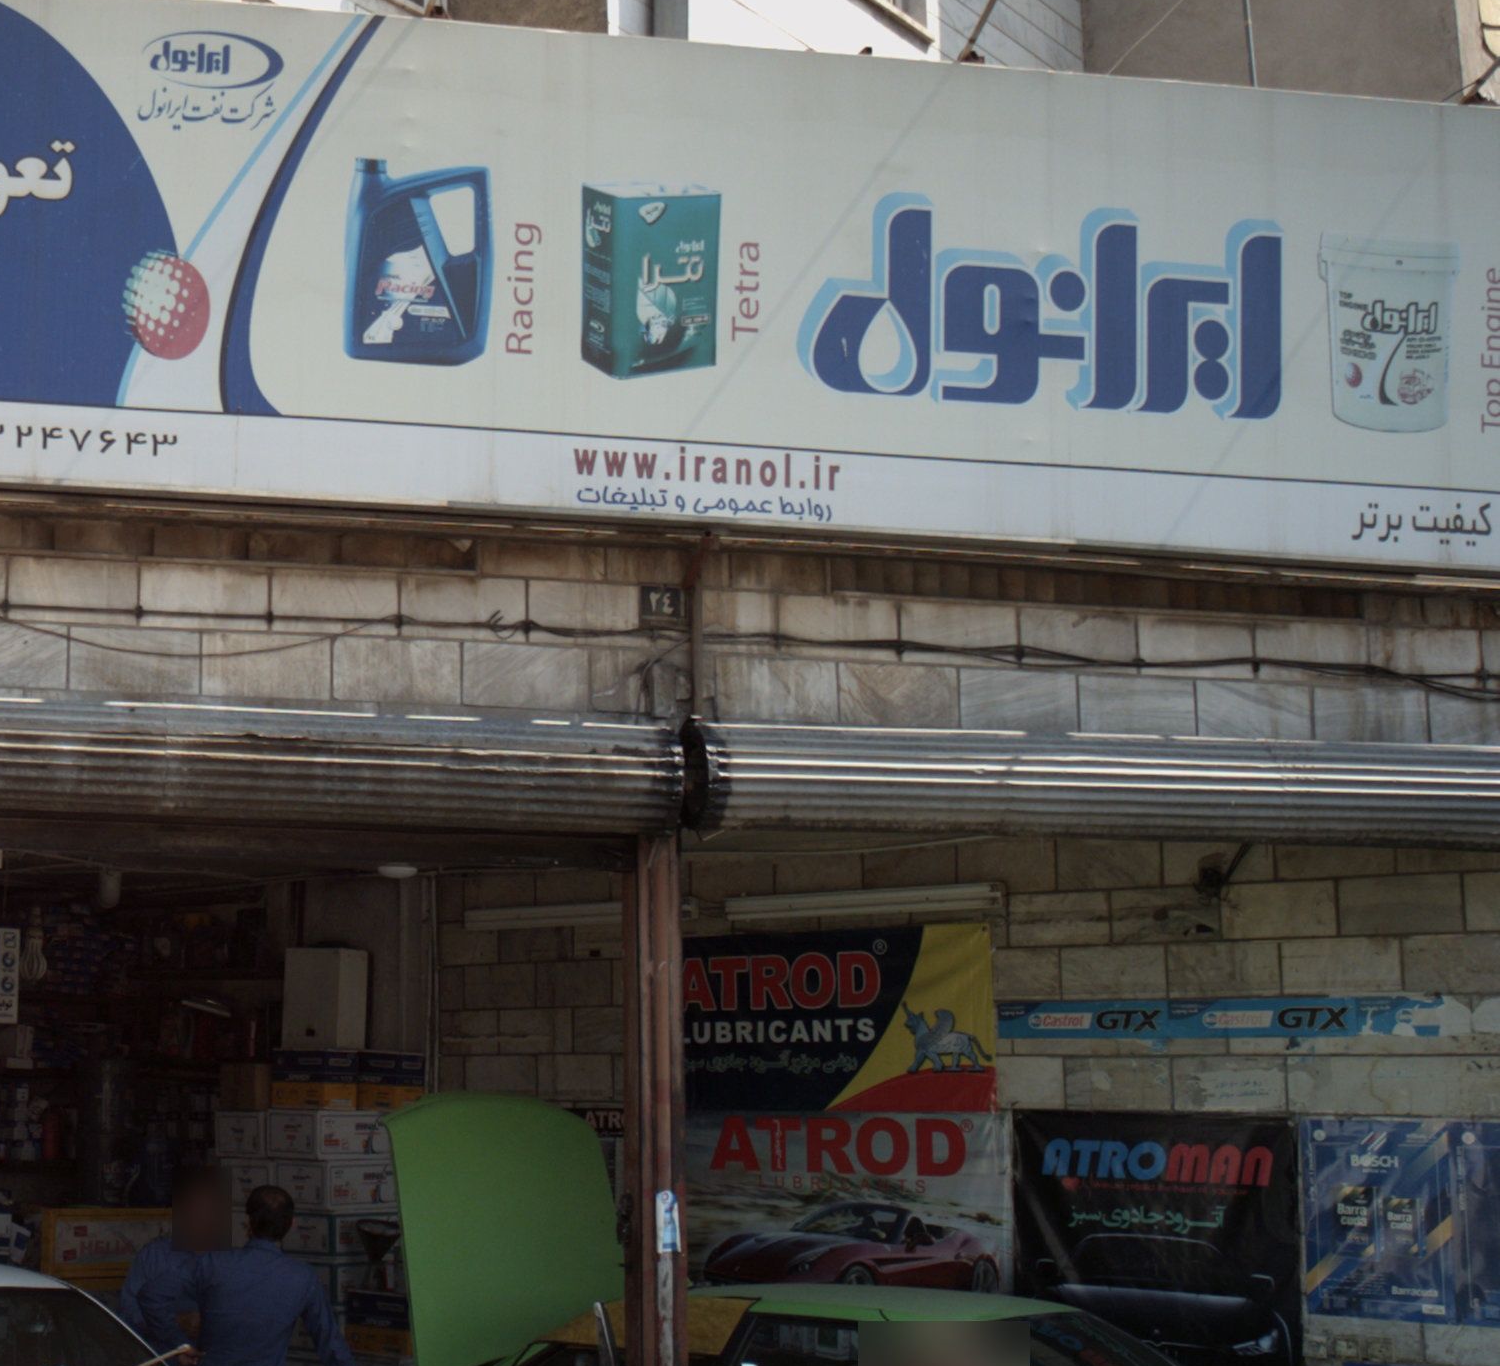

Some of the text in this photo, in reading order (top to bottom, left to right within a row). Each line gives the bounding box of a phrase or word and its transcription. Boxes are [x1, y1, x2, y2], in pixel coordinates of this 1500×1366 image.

[137, 81, 276, 131] شرکت نفت ایرانول
[505, 222, 542, 355] Racing
[731, 241, 760, 342] Tetra
[799, 193, 1284, 421] ایرانول
[573, 445, 841, 492] www.iranol.ir
[576, 485, 832, 523] روابط عمومی و تبلیغات
[1351, 502, 1491, 546] کیفیت برتر
[682, 950, 882, 1012] ATROD
[1043, 1014, 1084, 1028] Castrol
[1096, 1009, 1161, 1032] GTX
[1277, 1006, 1348, 1030] GTX
[710, 1115, 966, 1177] ATROD
[1040, 1137, 1275, 1188] ATROMAN
[756, 1174, 926, 1194] LUBRICANTS
[1336, 1202, 1368, 1217] Barra
